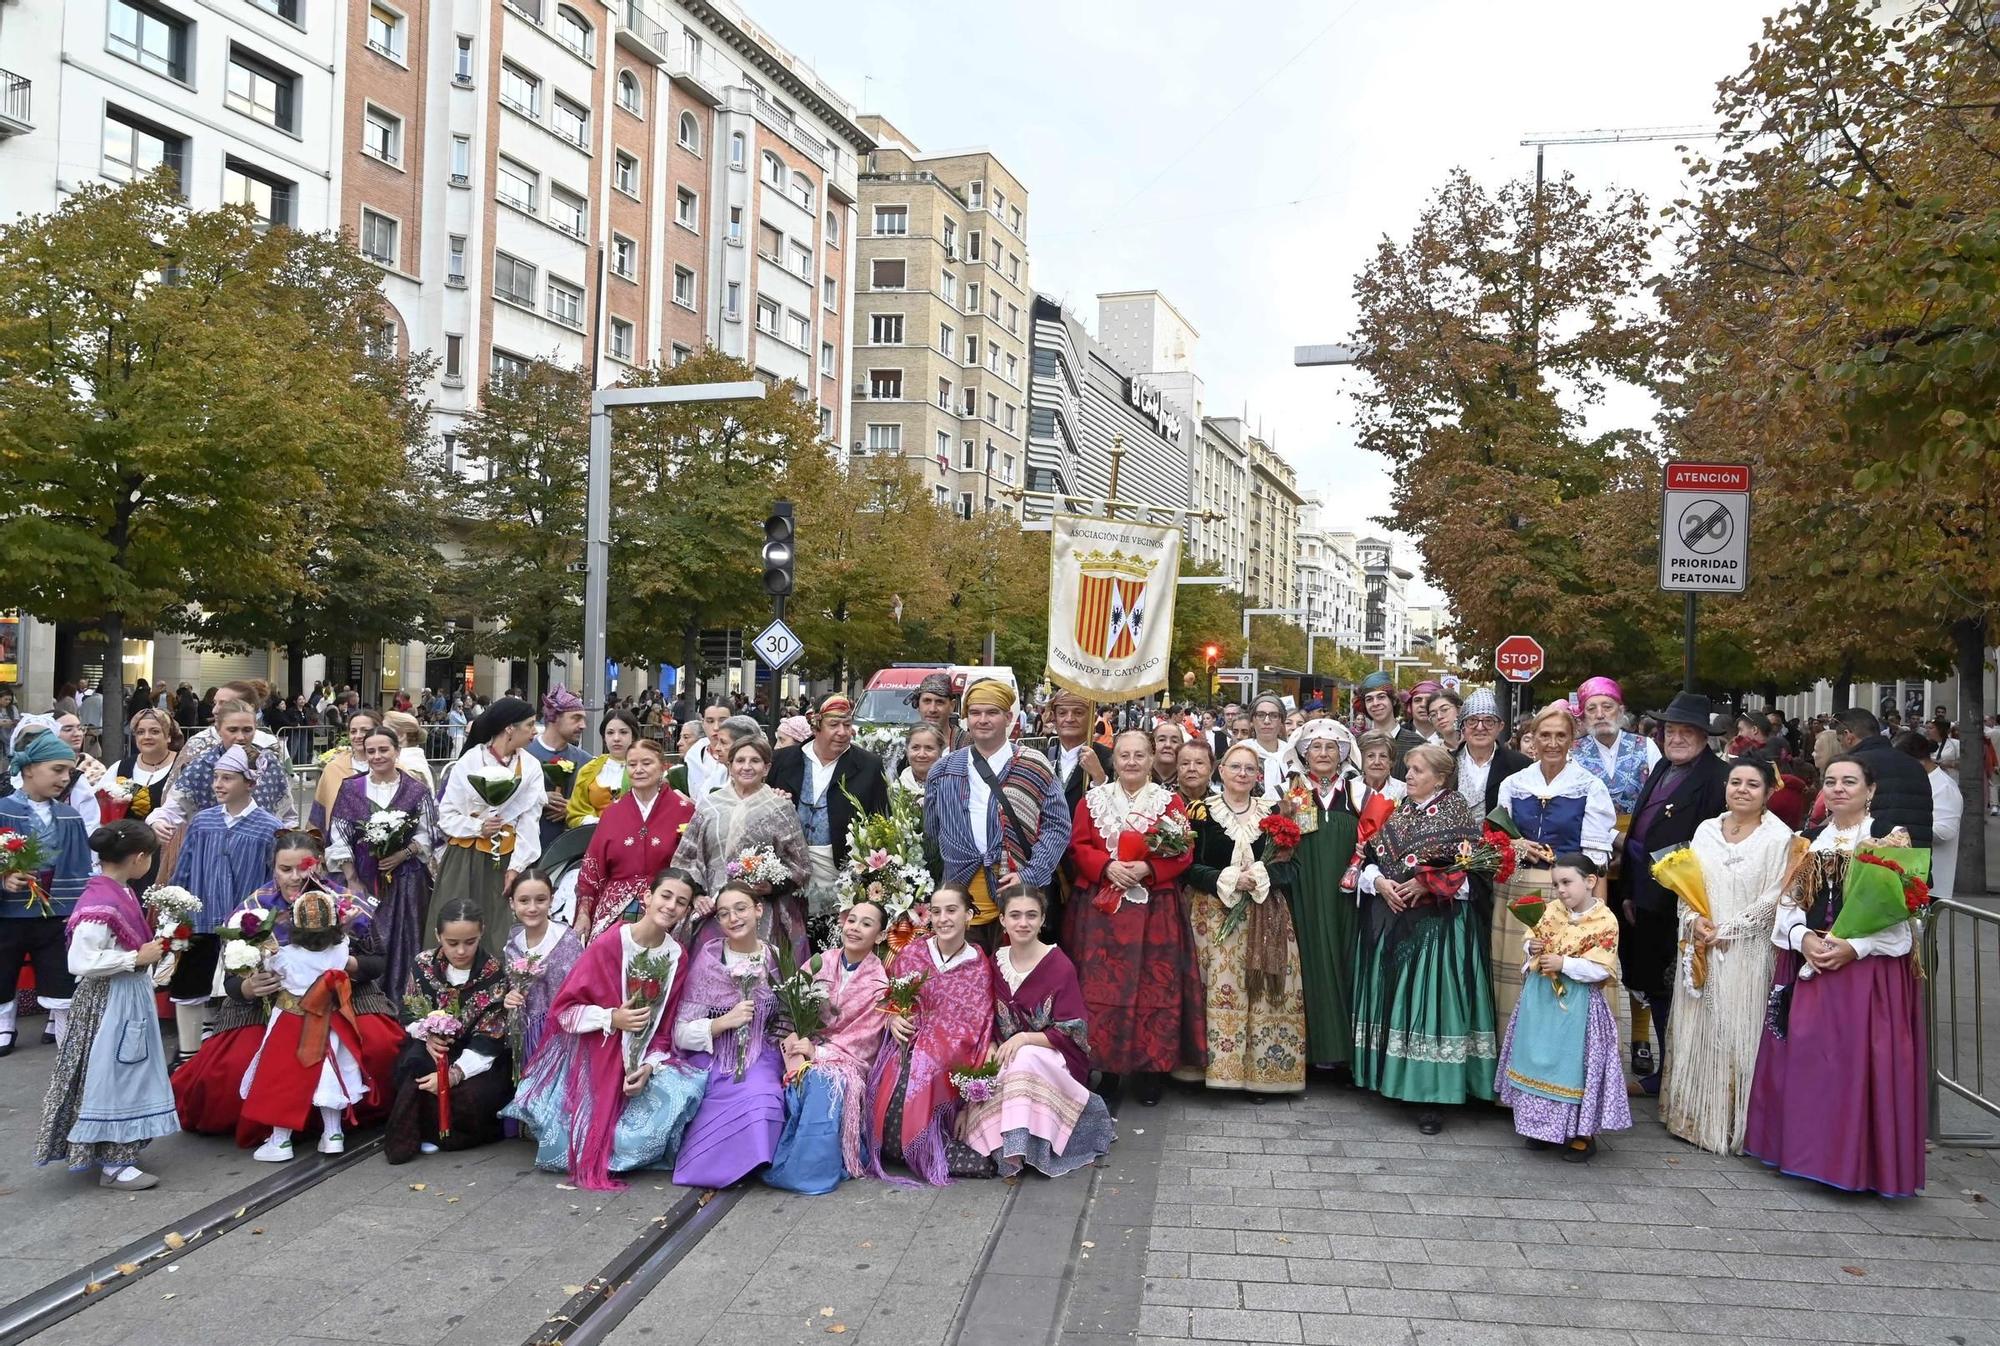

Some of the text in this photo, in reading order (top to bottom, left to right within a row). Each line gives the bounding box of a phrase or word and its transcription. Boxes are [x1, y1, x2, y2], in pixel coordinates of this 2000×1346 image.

[1675, 472, 1740, 483] ATENCIÓN
[1070, 529, 1164, 549] ASOCIACIÓN DE VECINOS
[1671, 558, 1738, 569] PRIORIDAD
[1671, 573, 1736, 584] PEATONAL
[766, 635, 788, 653] 30
[1053, 647, 1100, 676] FERNANDO
[1114, 657, 1159, 677] CATÓLICO
[1501, 653, 1539, 665] STOP
